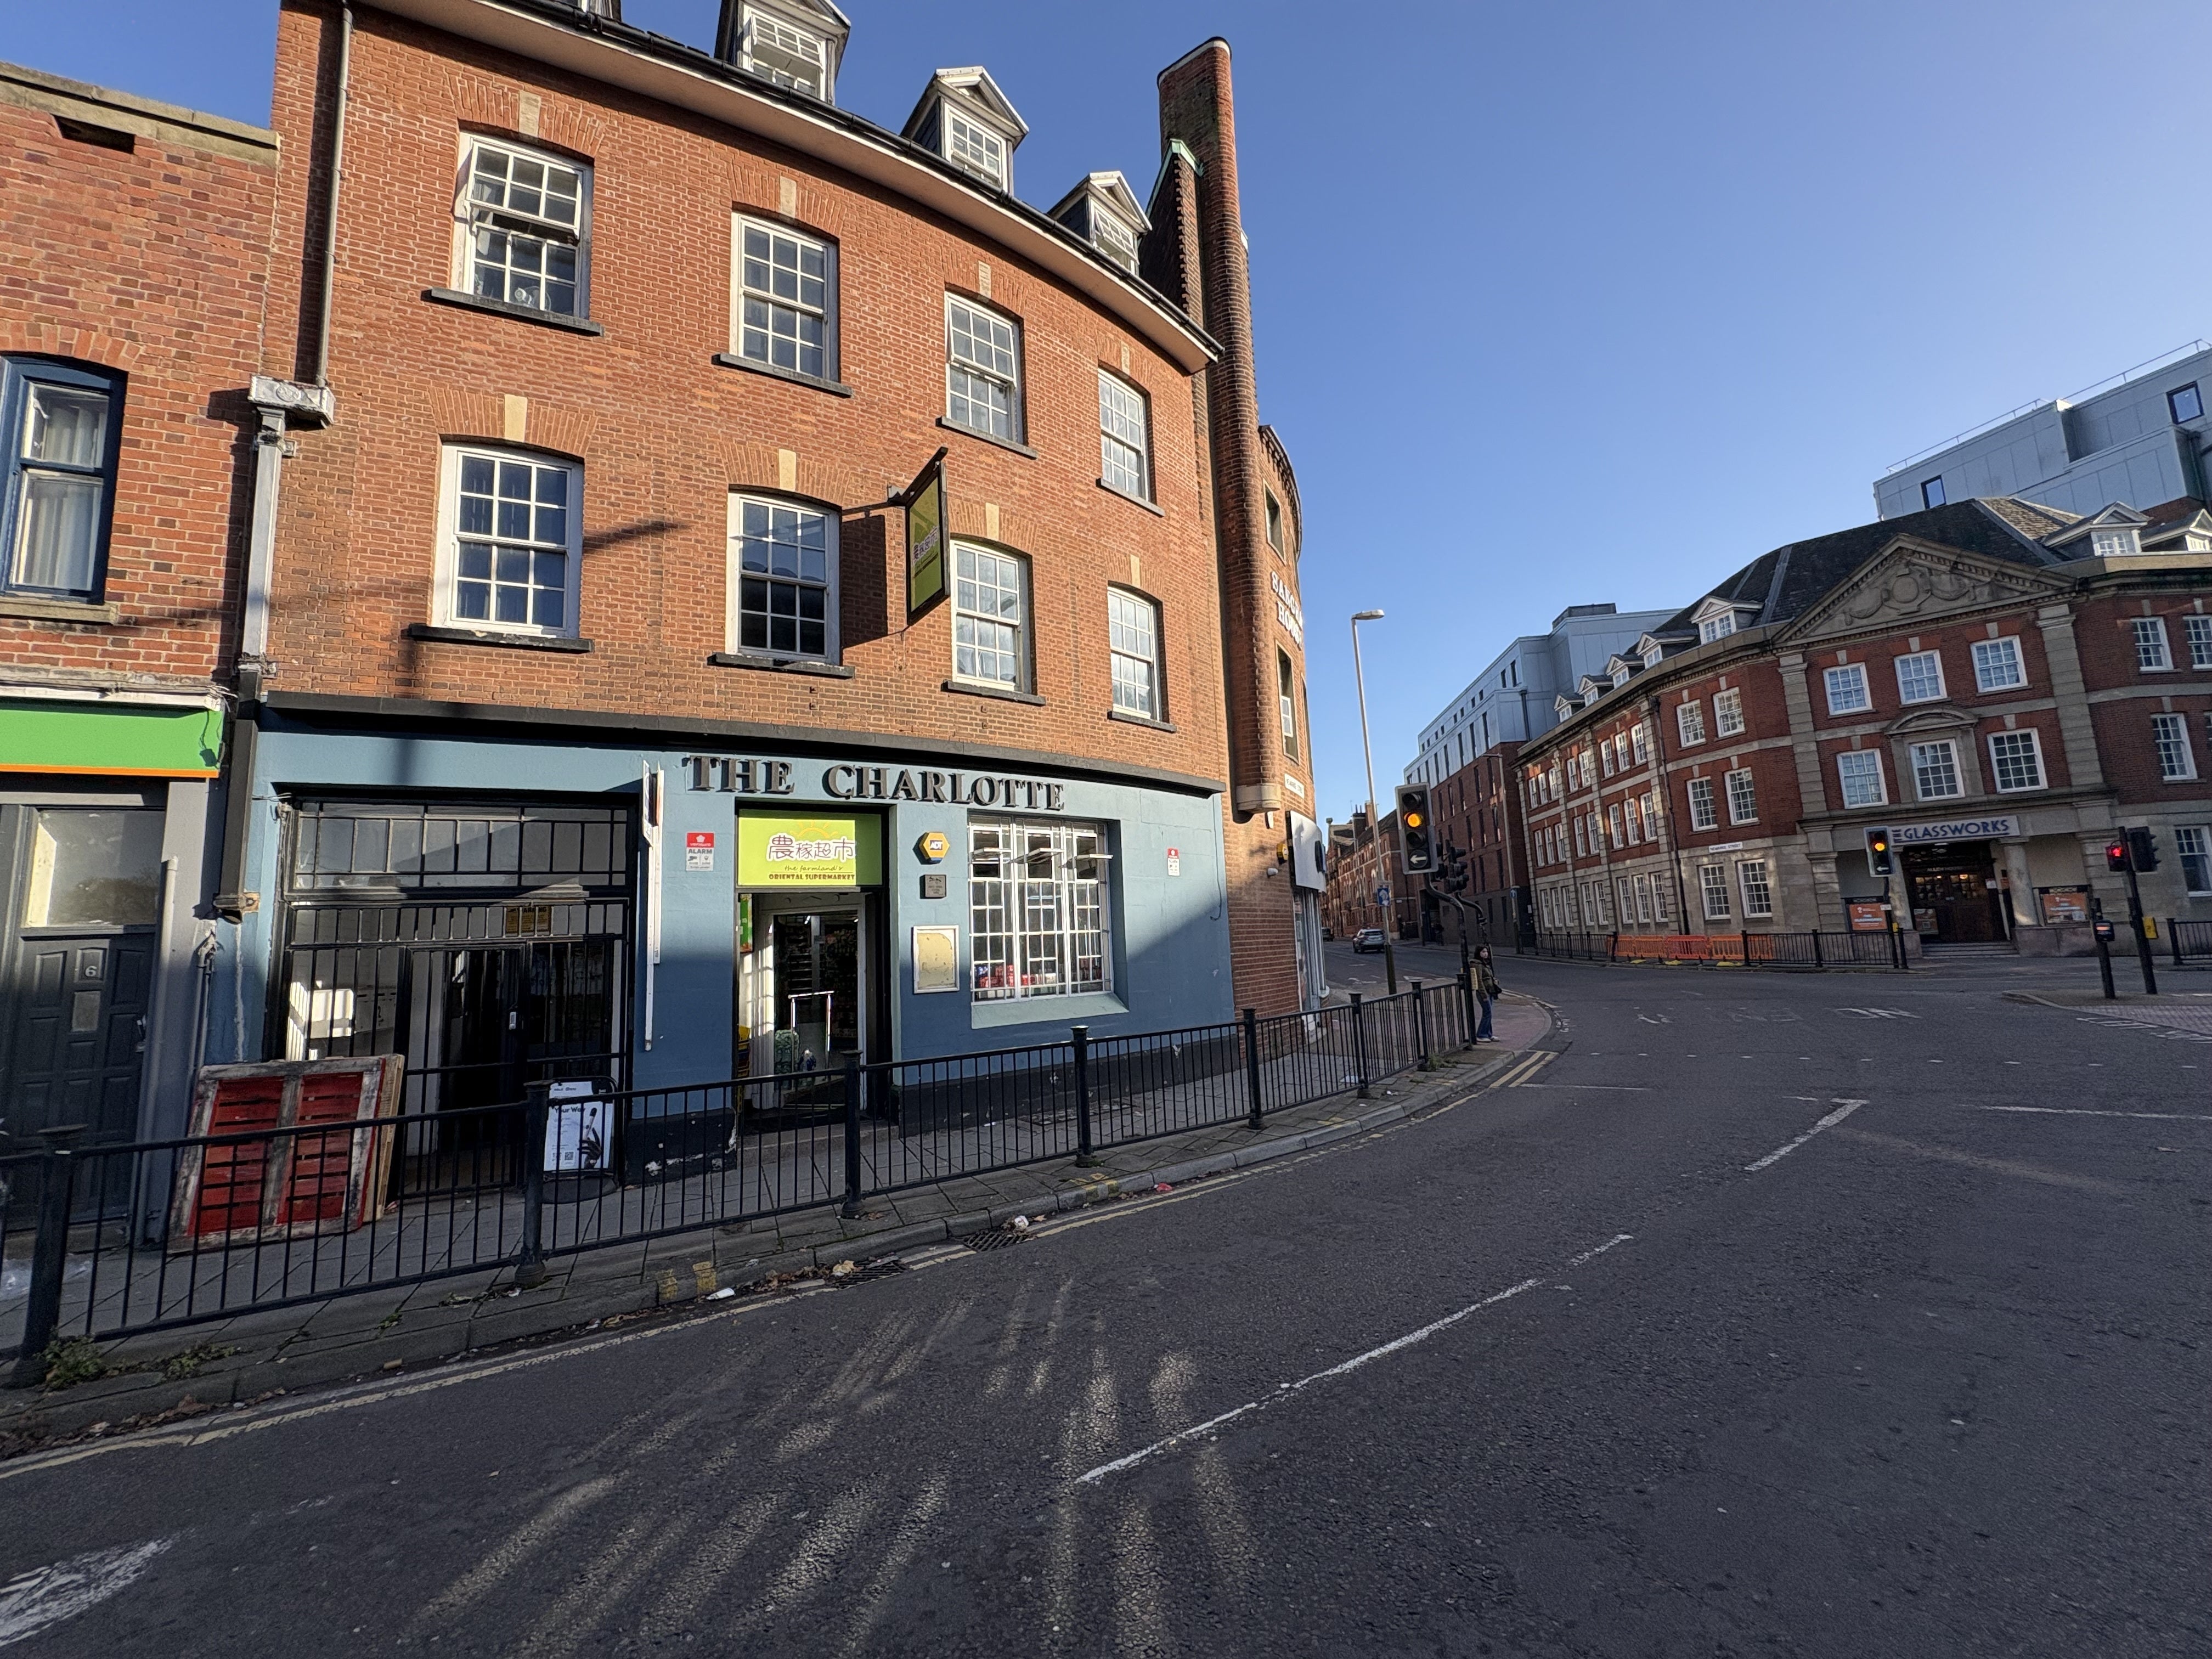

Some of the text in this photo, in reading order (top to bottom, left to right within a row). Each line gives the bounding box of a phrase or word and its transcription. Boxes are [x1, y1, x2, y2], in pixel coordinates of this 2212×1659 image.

[688, 755, 1064, 810] THE CHARLOTTE
[1904, 820, 2009, 839] GLASSWORKS
[930, 841, 943, 849] ADT
[85, 966, 97, 977] 6
